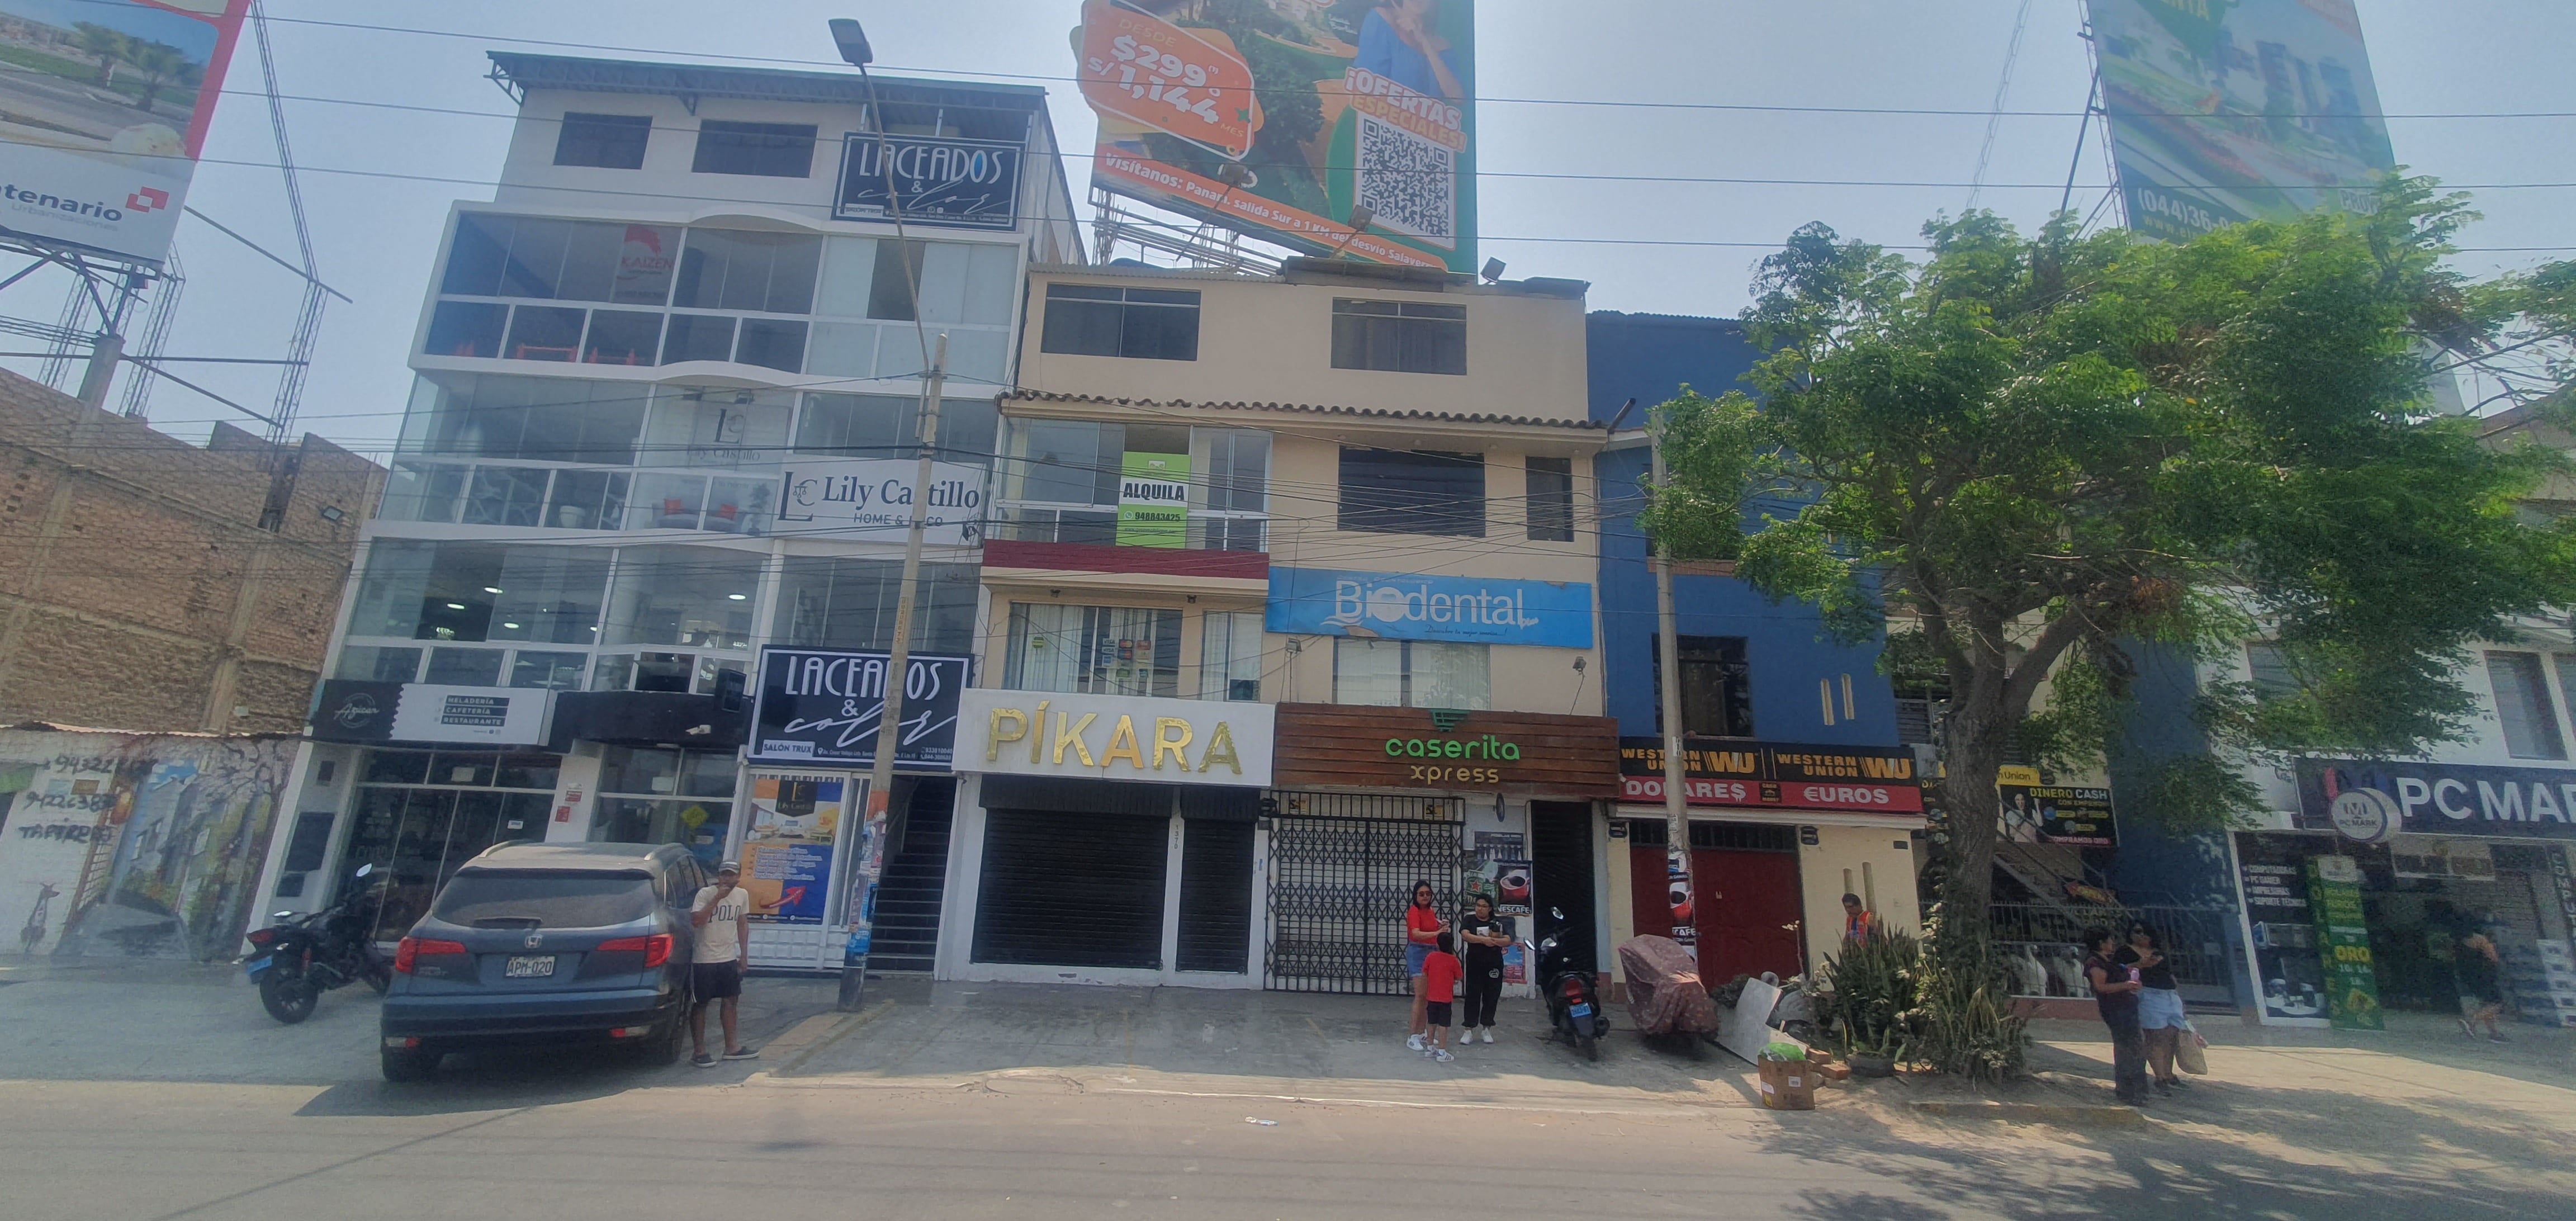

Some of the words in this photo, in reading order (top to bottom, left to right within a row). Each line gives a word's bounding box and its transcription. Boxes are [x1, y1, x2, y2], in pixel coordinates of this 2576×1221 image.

[1119, 19, 1177, 47] DESDE
[1110, 35, 1206, 87] $299
[1118, 64, 1220, 124] 1,144
[1346, 70, 1461, 130] ¡OFERTAS
[1220, 123, 1244, 137] MES
[1353, 94, 1466, 150] ESPECIALES!
[860, 143, 1004, 184] LACEADOS
[911, 181, 923, 193] &
[0, 184, 122, 221] tenario
[1105, 152, 1182, 190] Visítanos:
[1233, 199, 1270, 219] salida
[1271, 209, 1291, 225] Sur
[1293, 218, 1301, 228] a
[1304, 219, 1311, 231] 1
[1388, 249, 1438, 268] Salaver
[621, 257, 674, 271] KAIZEN
[822, 475, 874, 510] Lily
[881, 479, 979, 508] Catillo
[1123, 482, 1185, 500] ALQUILA
[854, 512, 891, 524] HOME
[895, 515, 903, 526] &
[909, 515, 943, 527] CO
[1135, 512, 1181, 522] 948843425
[785, 656, 942, 701] LACEAOS
[841, 699, 859, 717] &
[444, 717, 502, 726] RESTAURANTE
[784, 699, 957, 747] colr
[986, 700, 1242, 775] PÍKARA
[1385, 735, 1520, 760] caserita
[792, 744, 812, 754] TRUX
[1621, 748, 1700, 760] WESTRN
[1647, 760, 1701, 772] UNN
[1708, 751, 1756, 774] WU
[1777, 754, 1857, 766] WESTERN
[1865, 757, 1912, 779] WU
[1410, 765, 1499, 785] xpress
[1803, 765, 1858, 778] UNION
[2004, 771, 2031, 780] Union
[1625, 780, 1746, 802] DOARE$
[1803, 787, 1890, 804] €UROS
[2030, 787, 2073, 798] DINERO
[2075, 789, 2108, 800] CASH
[2396, 777, 2473, 820] PC
[708, 905, 741, 923] POLO
